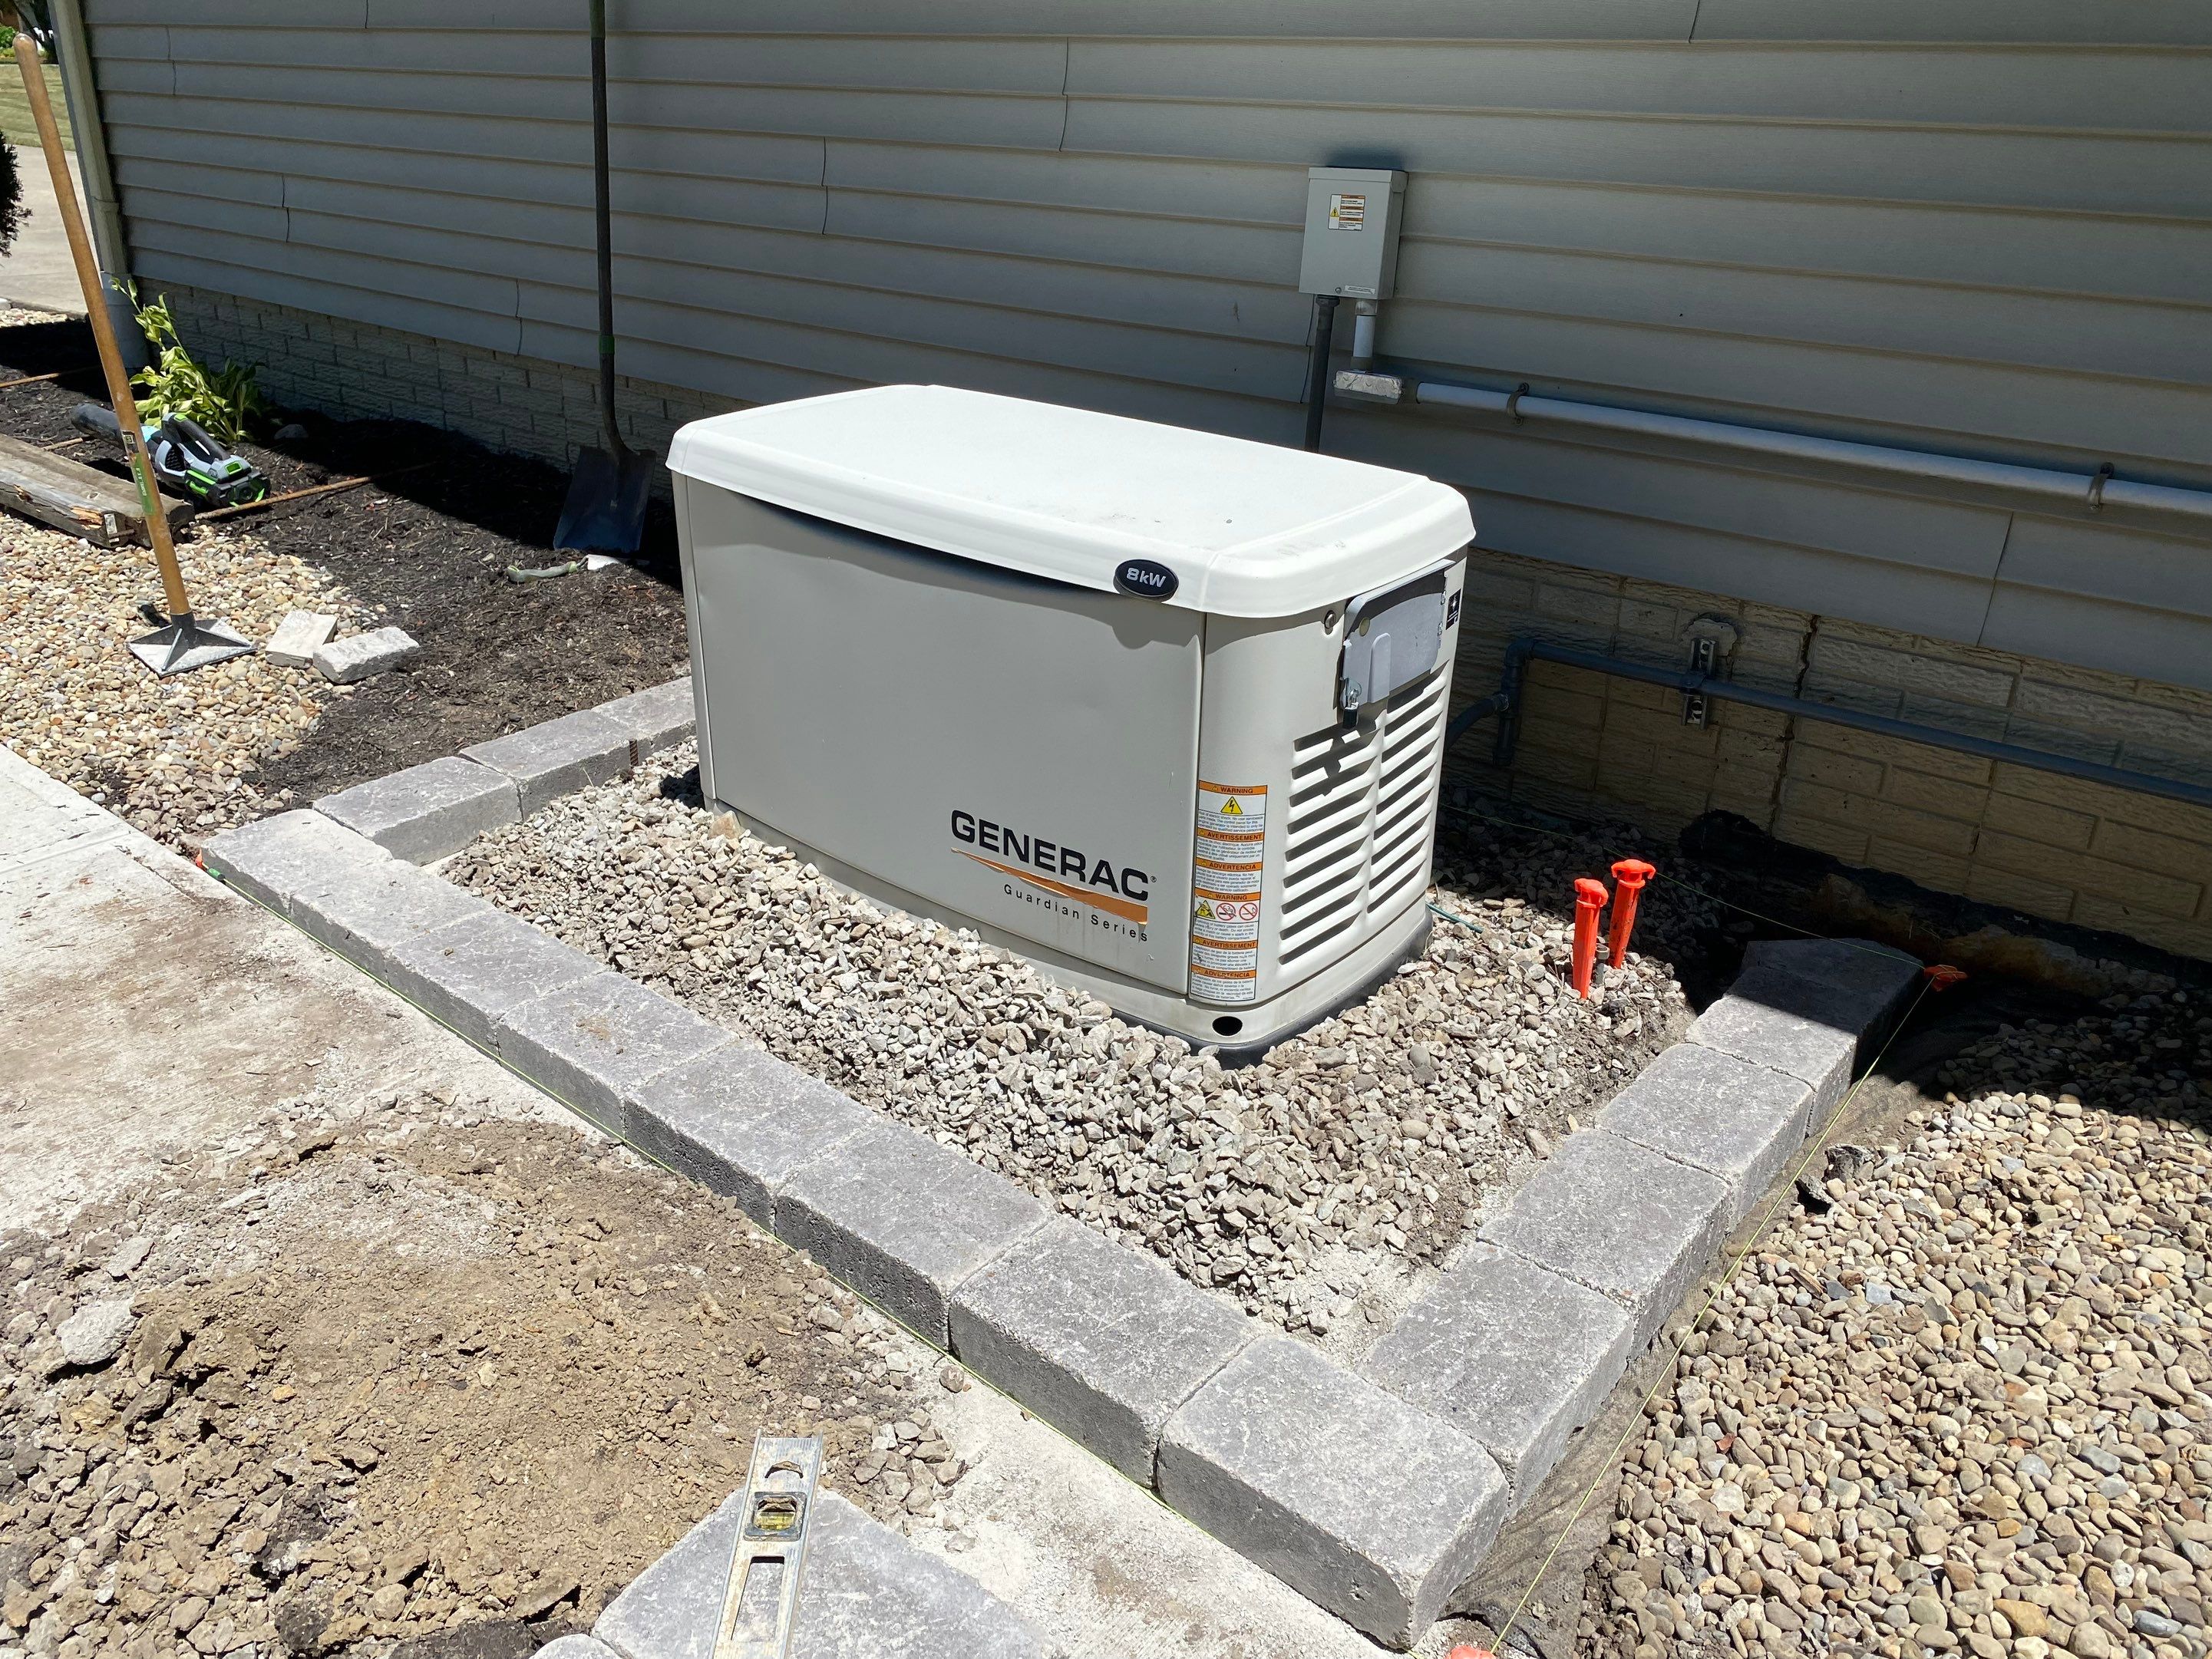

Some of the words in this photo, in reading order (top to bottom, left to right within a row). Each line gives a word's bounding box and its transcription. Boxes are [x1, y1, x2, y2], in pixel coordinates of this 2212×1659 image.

[1126, 567, 1167, 588] 8kW
[1207, 832, 1262, 841] AVERTISSEMENT
[951, 810, 1149, 902] GENERAC
[1004, 883, 1080, 919] Guardian
[1091, 913, 1148, 942] Series
[1202, 939, 1256, 948] AVERTISSEMENT
